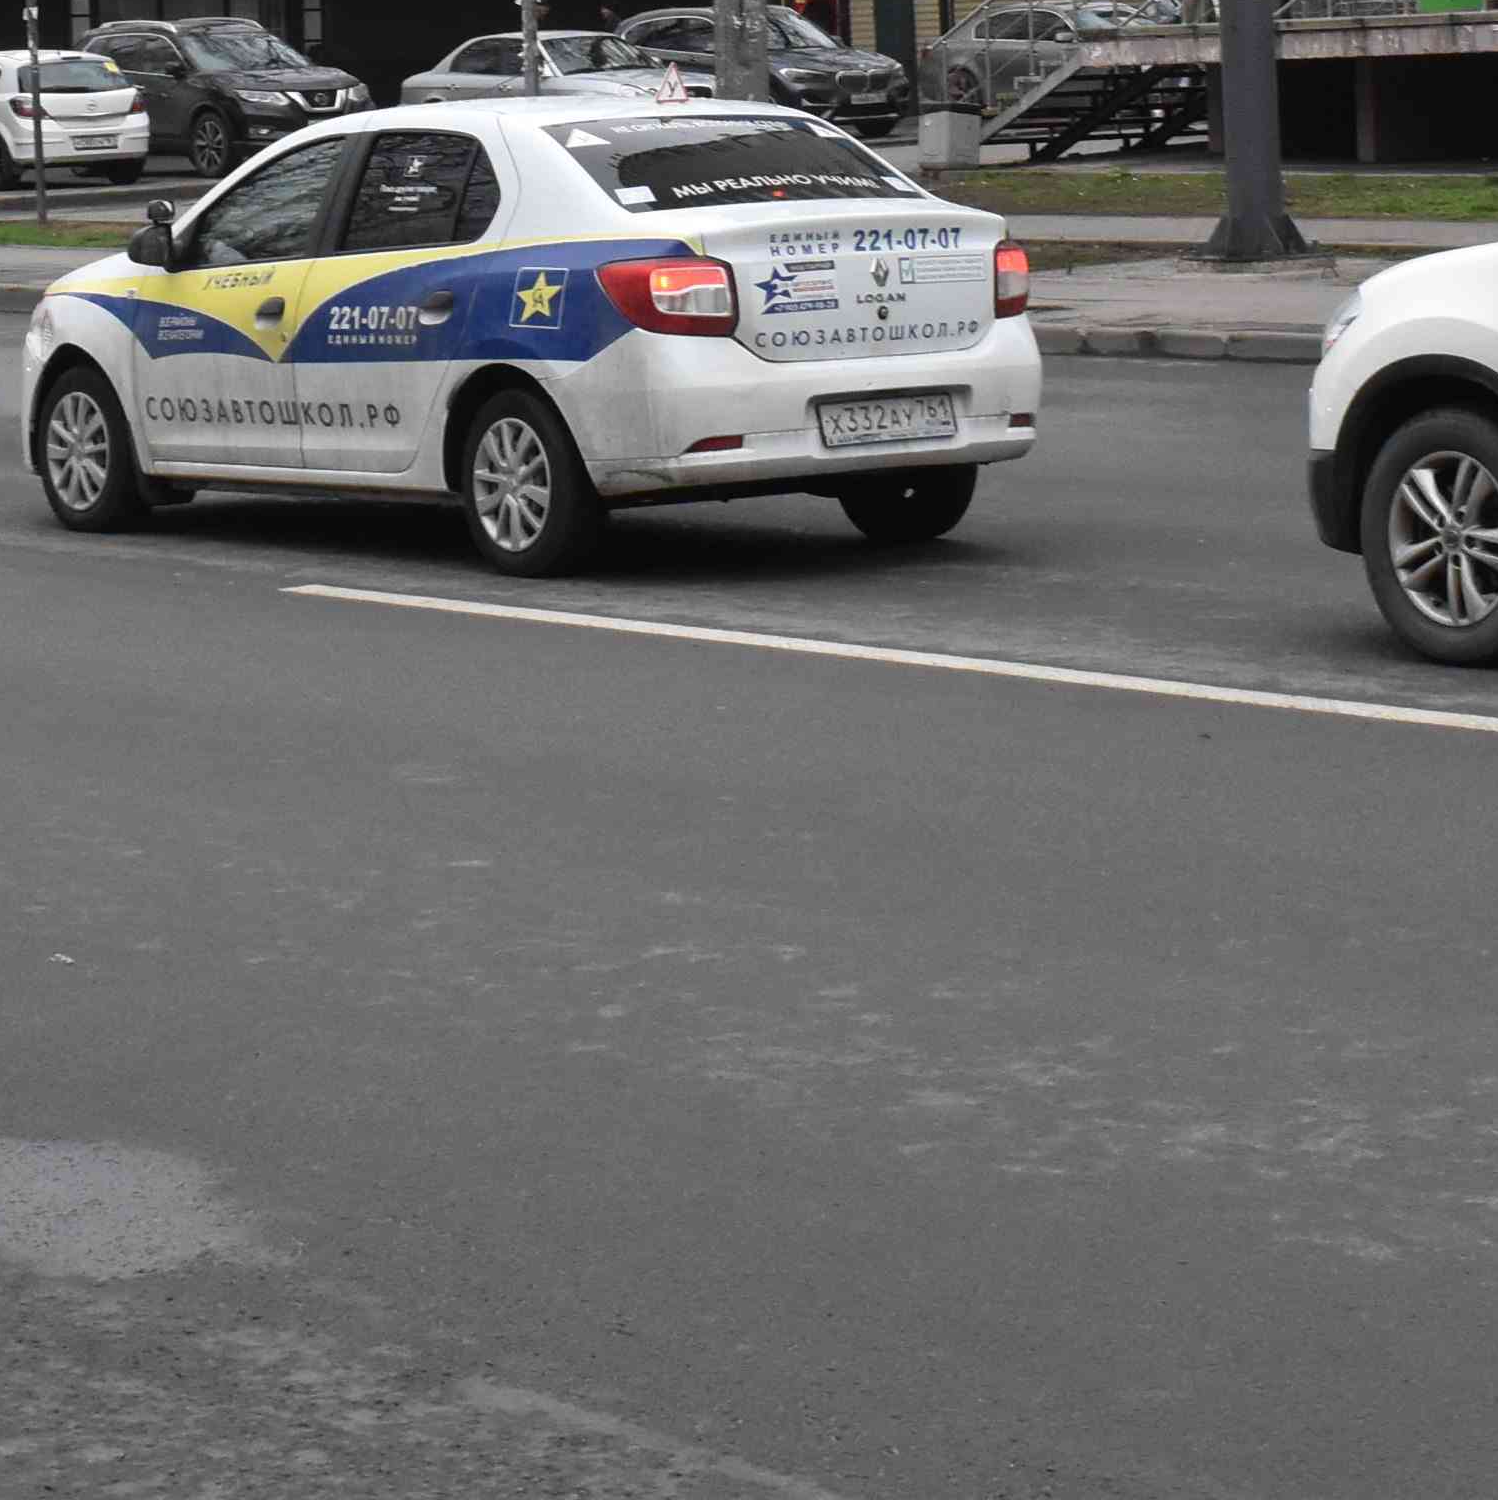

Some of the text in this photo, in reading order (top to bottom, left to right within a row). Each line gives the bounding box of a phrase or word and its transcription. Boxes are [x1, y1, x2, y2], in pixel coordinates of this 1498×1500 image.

[672, 173, 880, 199] МЫ РЕАЛЬНО УЧИМ!
[769, 227, 962, 253] ЕДИНЫЙ 221-07-07
[769, 243, 840, 257] НОМЕР
[856, 292, 906, 304] LOGAN
[328, 305, 418, 331] 221-07-07
[327, 333, 418, 345] ЕДИНЫЙ НОМЕР
[754, 320, 981, 349] СОЮЗАВТОШКОЛ.РФ
[145, 396, 401, 429] СОЮЗАВТОШКОЛ.РФ
